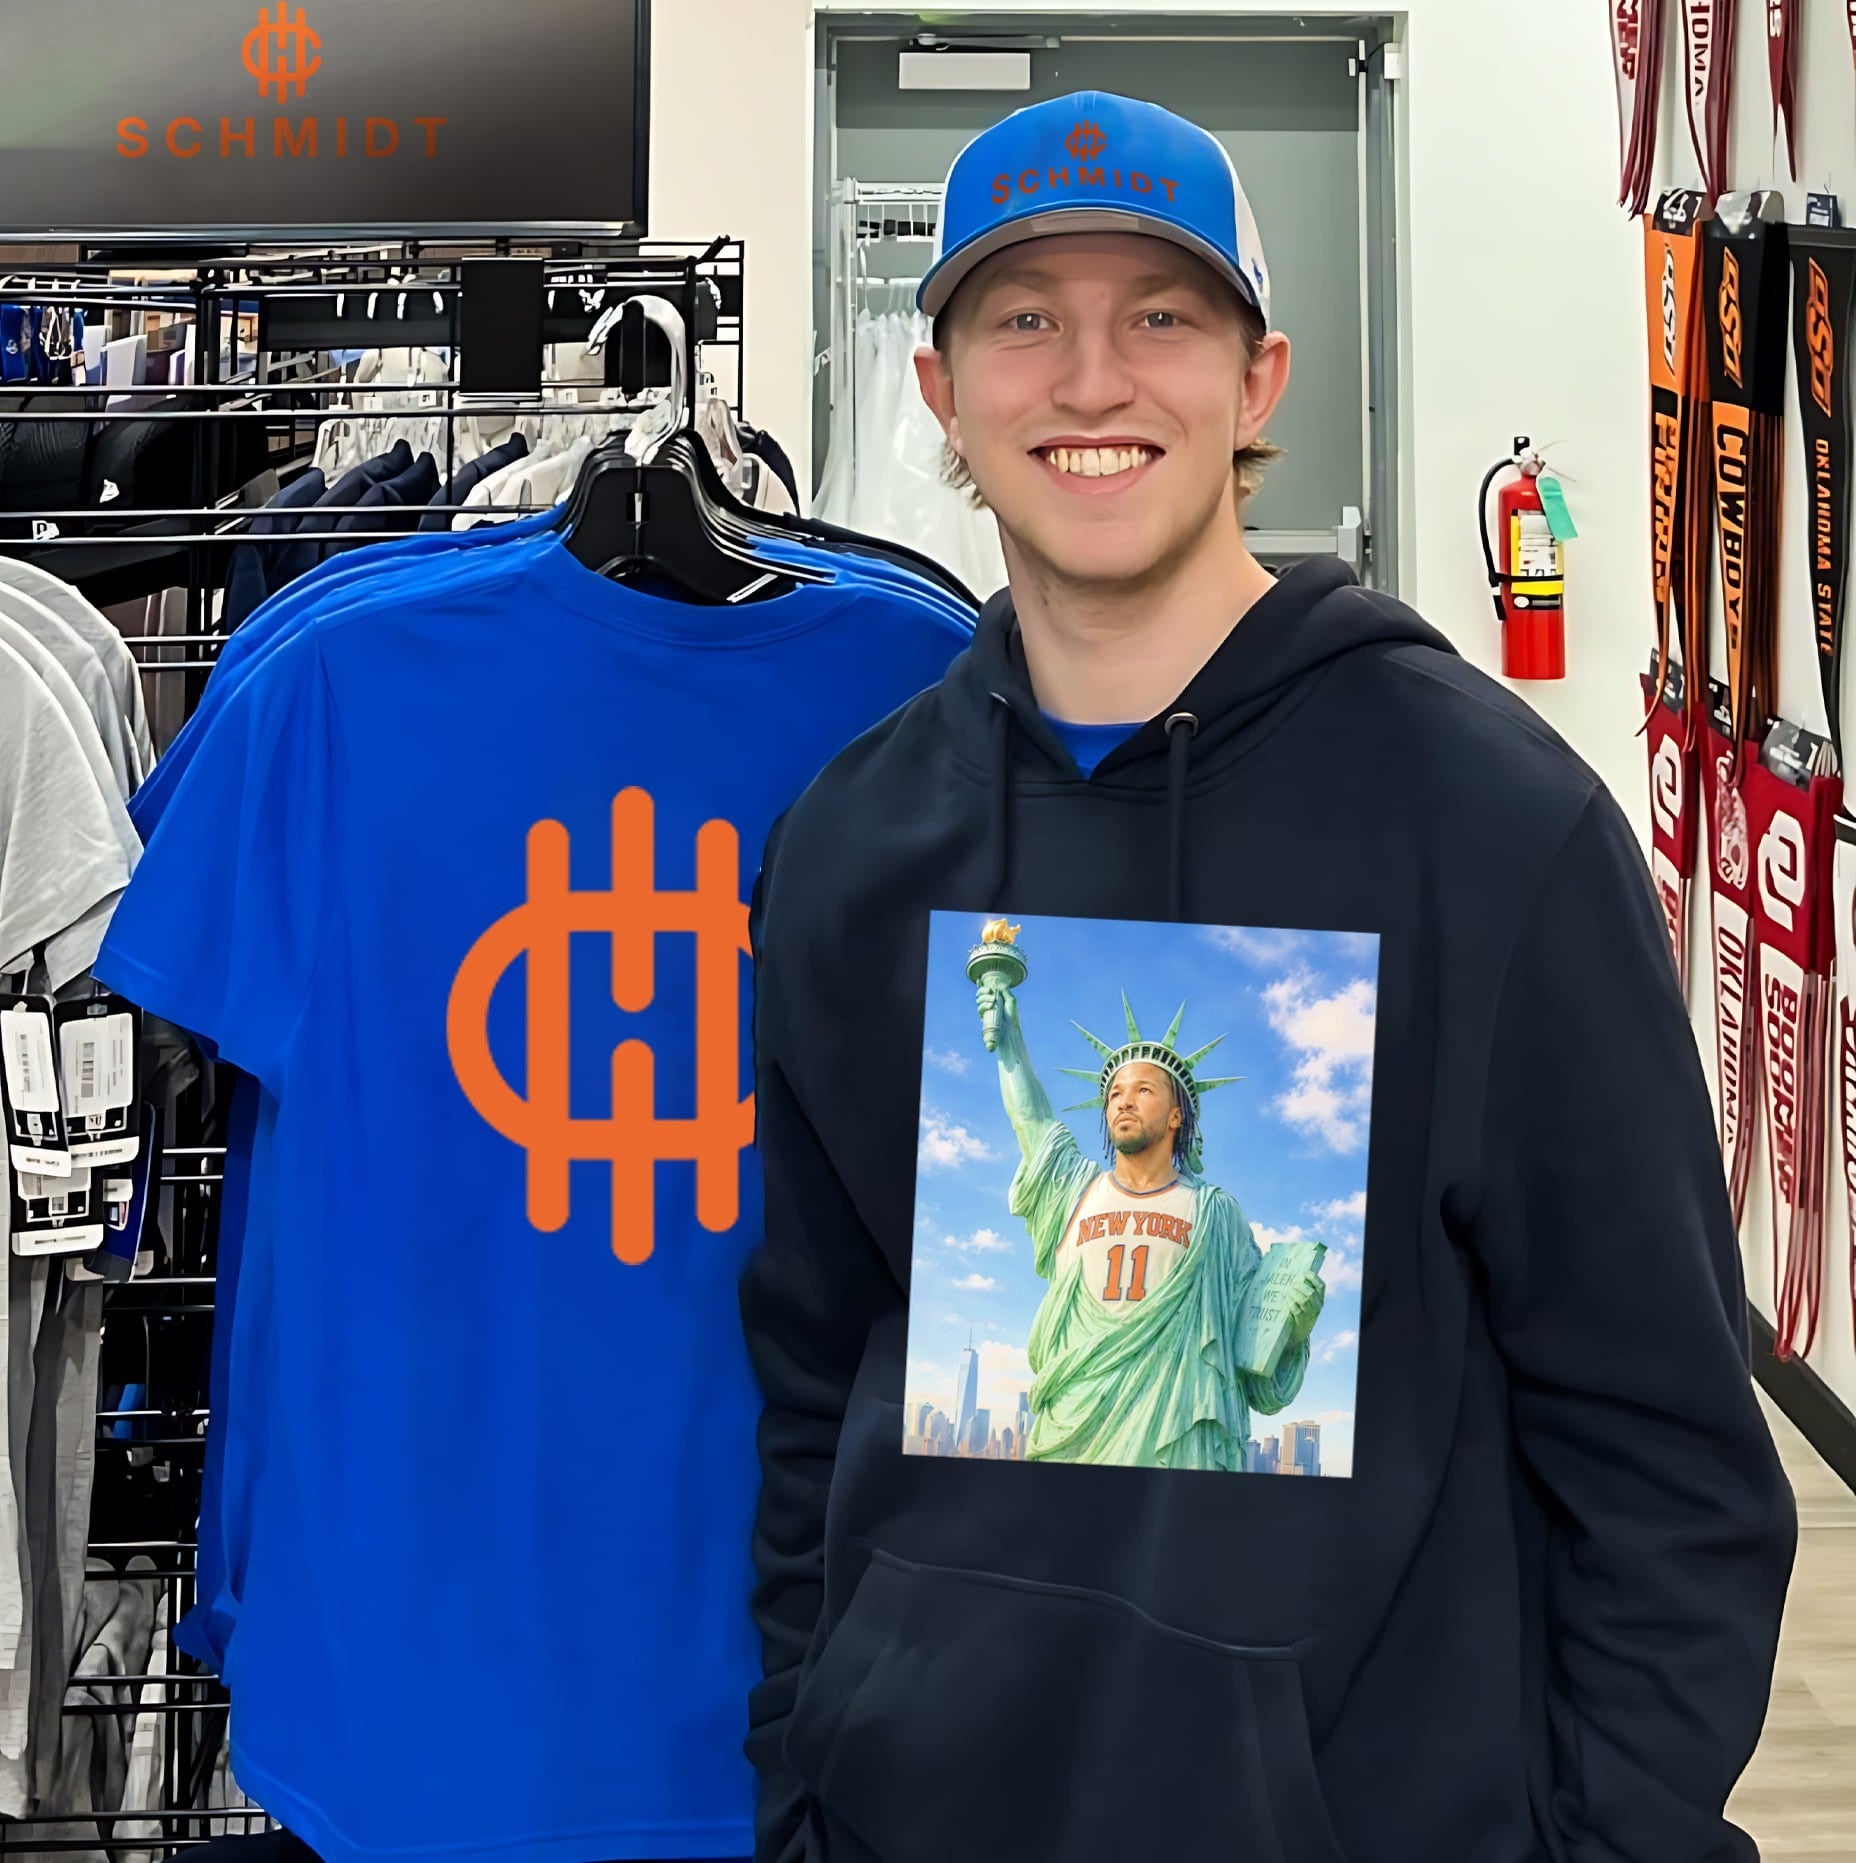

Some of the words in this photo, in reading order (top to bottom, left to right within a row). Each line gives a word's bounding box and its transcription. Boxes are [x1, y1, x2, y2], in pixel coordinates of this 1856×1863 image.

[116, 116, 447, 159] SCHMIDT
[991, 166, 1179, 205] SCHMIDT
[1815, 438, 1832, 570] OKLAHOMA
[1817, 583, 1833, 656] STATE
[1076, 1211, 1131, 1247] NEW
[1132, 1211, 1193, 1248] YORK
[1102, 1244, 1150, 1301] 11
